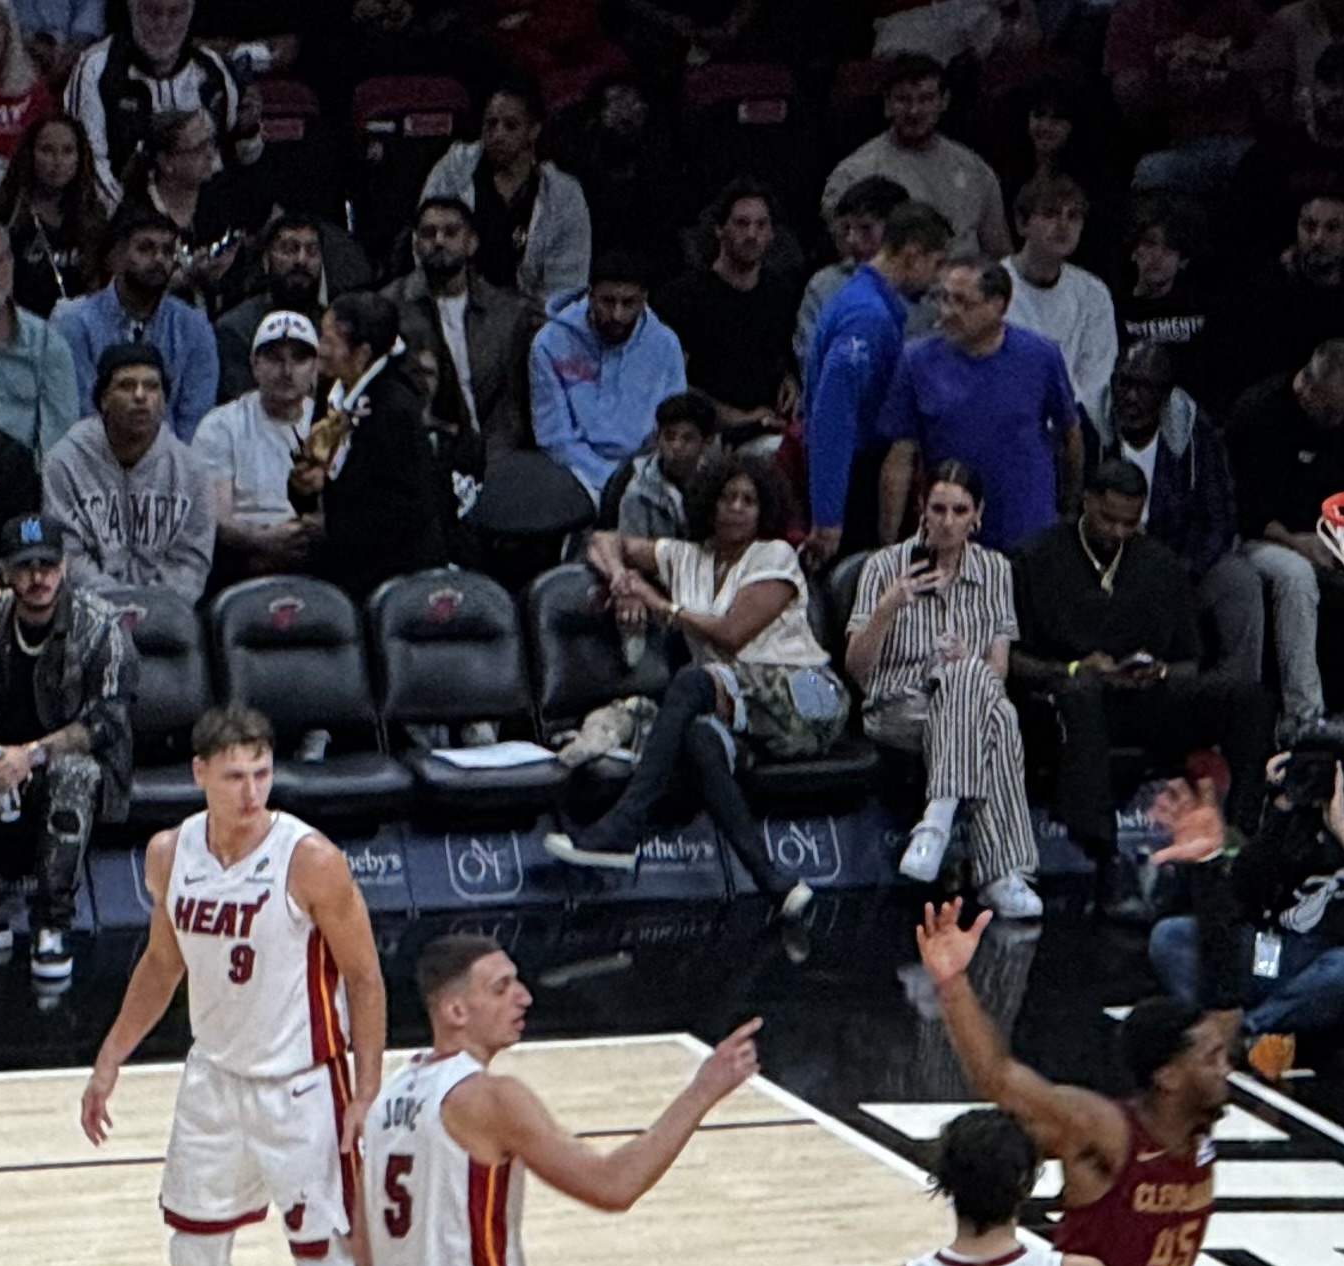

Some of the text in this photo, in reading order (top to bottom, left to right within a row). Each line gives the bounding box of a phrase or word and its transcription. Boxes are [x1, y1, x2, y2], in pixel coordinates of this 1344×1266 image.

[174, 888, 271, 938] HEAT
[228, 944, 256, 985] 9
[383, 1153, 415, 1239] 5
